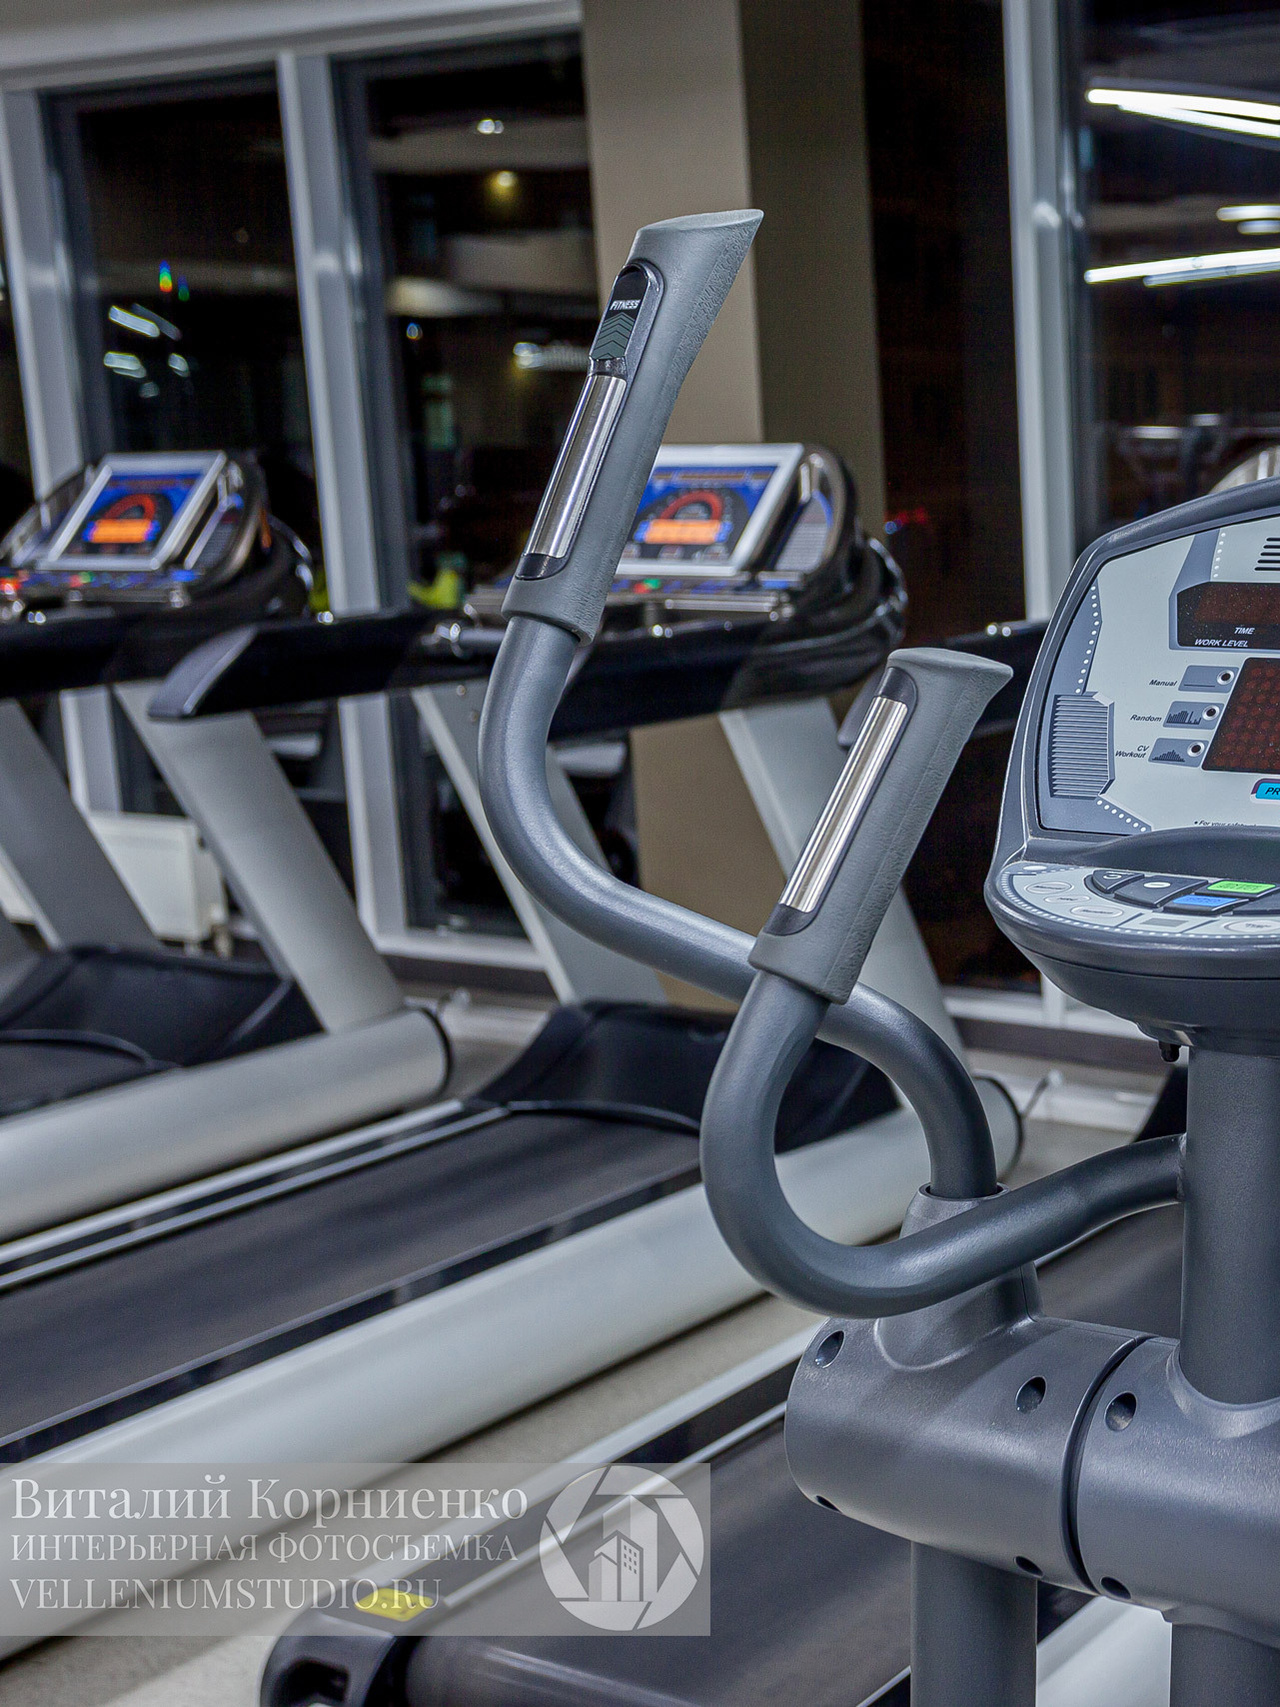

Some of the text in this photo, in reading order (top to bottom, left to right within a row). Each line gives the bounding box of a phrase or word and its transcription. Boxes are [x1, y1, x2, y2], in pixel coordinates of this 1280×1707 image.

[609, 299, 641, 311] FITNESS
[1234, 627, 1255, 635] TIME
[1194, 638, 1249, 648] WORK LEVEL
[1149, 679, 1177, 687] Manual
[1130, 714, 1162, 722] Random
